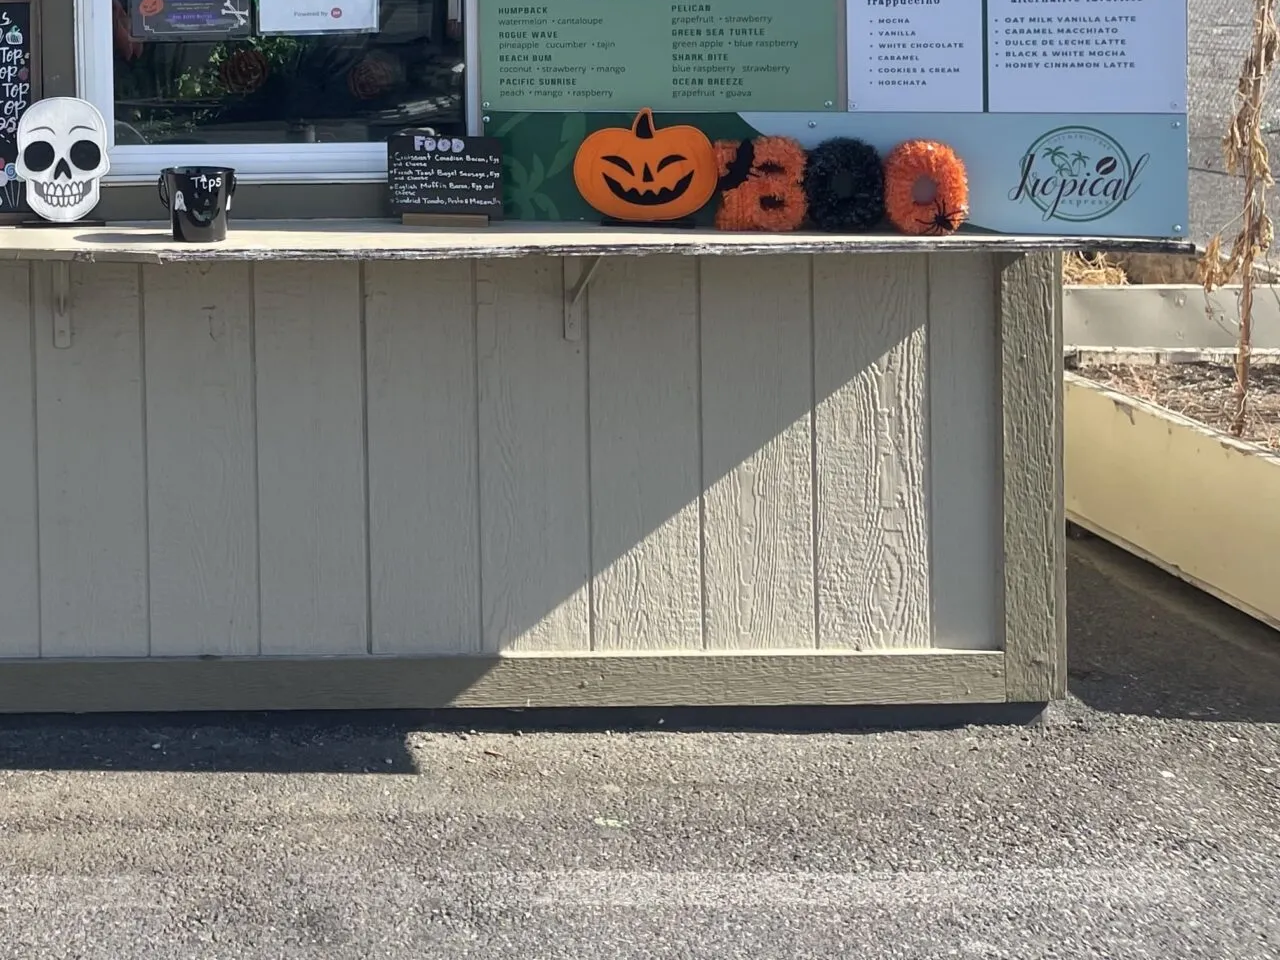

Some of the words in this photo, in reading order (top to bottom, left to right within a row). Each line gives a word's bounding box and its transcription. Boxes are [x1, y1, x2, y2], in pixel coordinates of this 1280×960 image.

[672, 28, 702, 36] GREEN
[706, 28, 724, 36] SEA
[729, 28, 765, 36] TURTLE
[0, 47, 23, 65] Top
[672, 53, 703, 61] SHARK
[708, 53, 728, 61] BITE
[2, 83, 29, 101] Top
[414, 136, 465, 152] FOOD
[190, 174, 222, 192] Tips
[714, 135, 970, 235] BOO
[1008, 153, 1150, 221] Tropical
